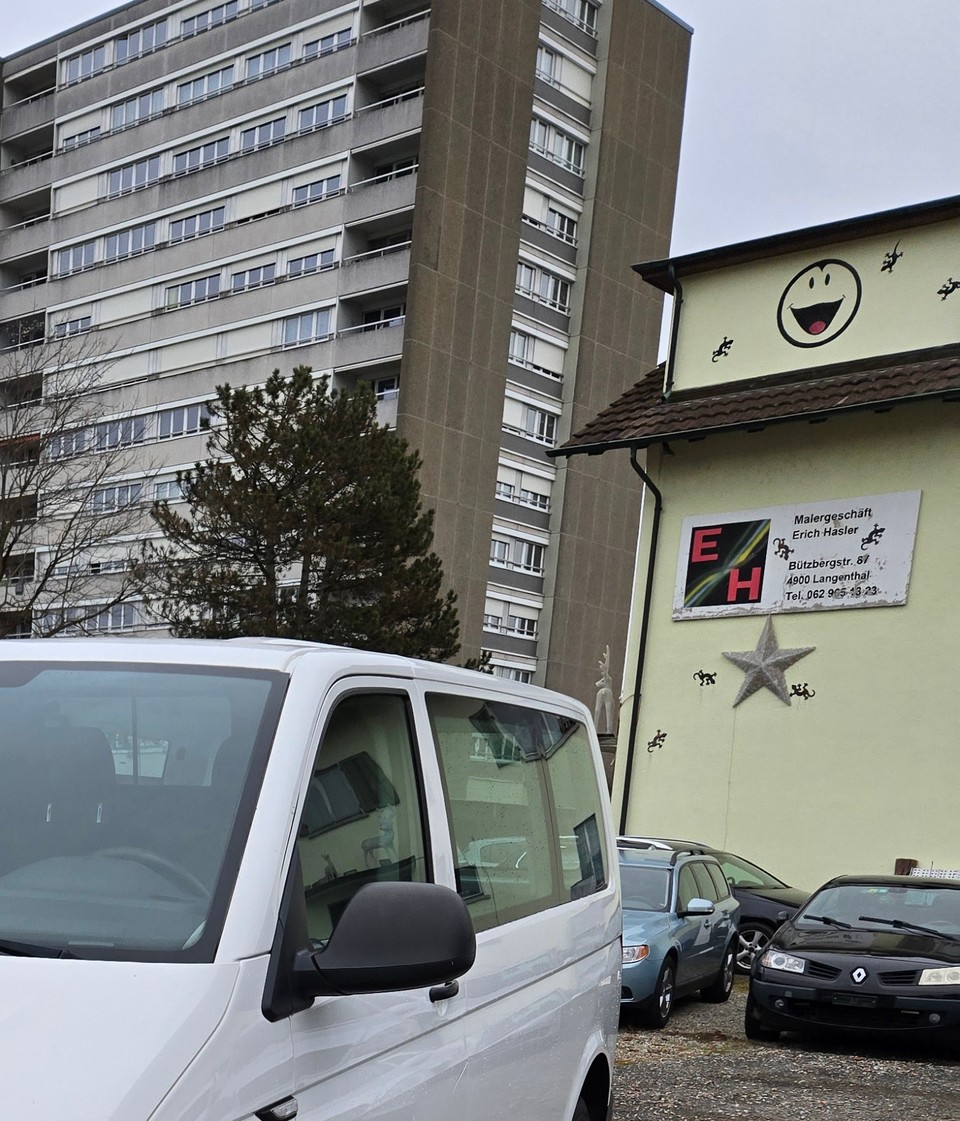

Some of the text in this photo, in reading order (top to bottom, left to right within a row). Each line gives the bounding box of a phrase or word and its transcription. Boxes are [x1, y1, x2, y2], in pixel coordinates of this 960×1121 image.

[794, 507, 872, 525] Malergeschäft
[792, 525, 859, 540] Erich Hasler
[691, 528, 722, 563] E
[788, 557, 853, 570] Bützbergstr.
[727, 567, 762, 602] H
[786, 570, 870, 585] 4900 Langenthal
[786, 590, 804, 601] Tel.
[807, 589, 825, 599] 062
